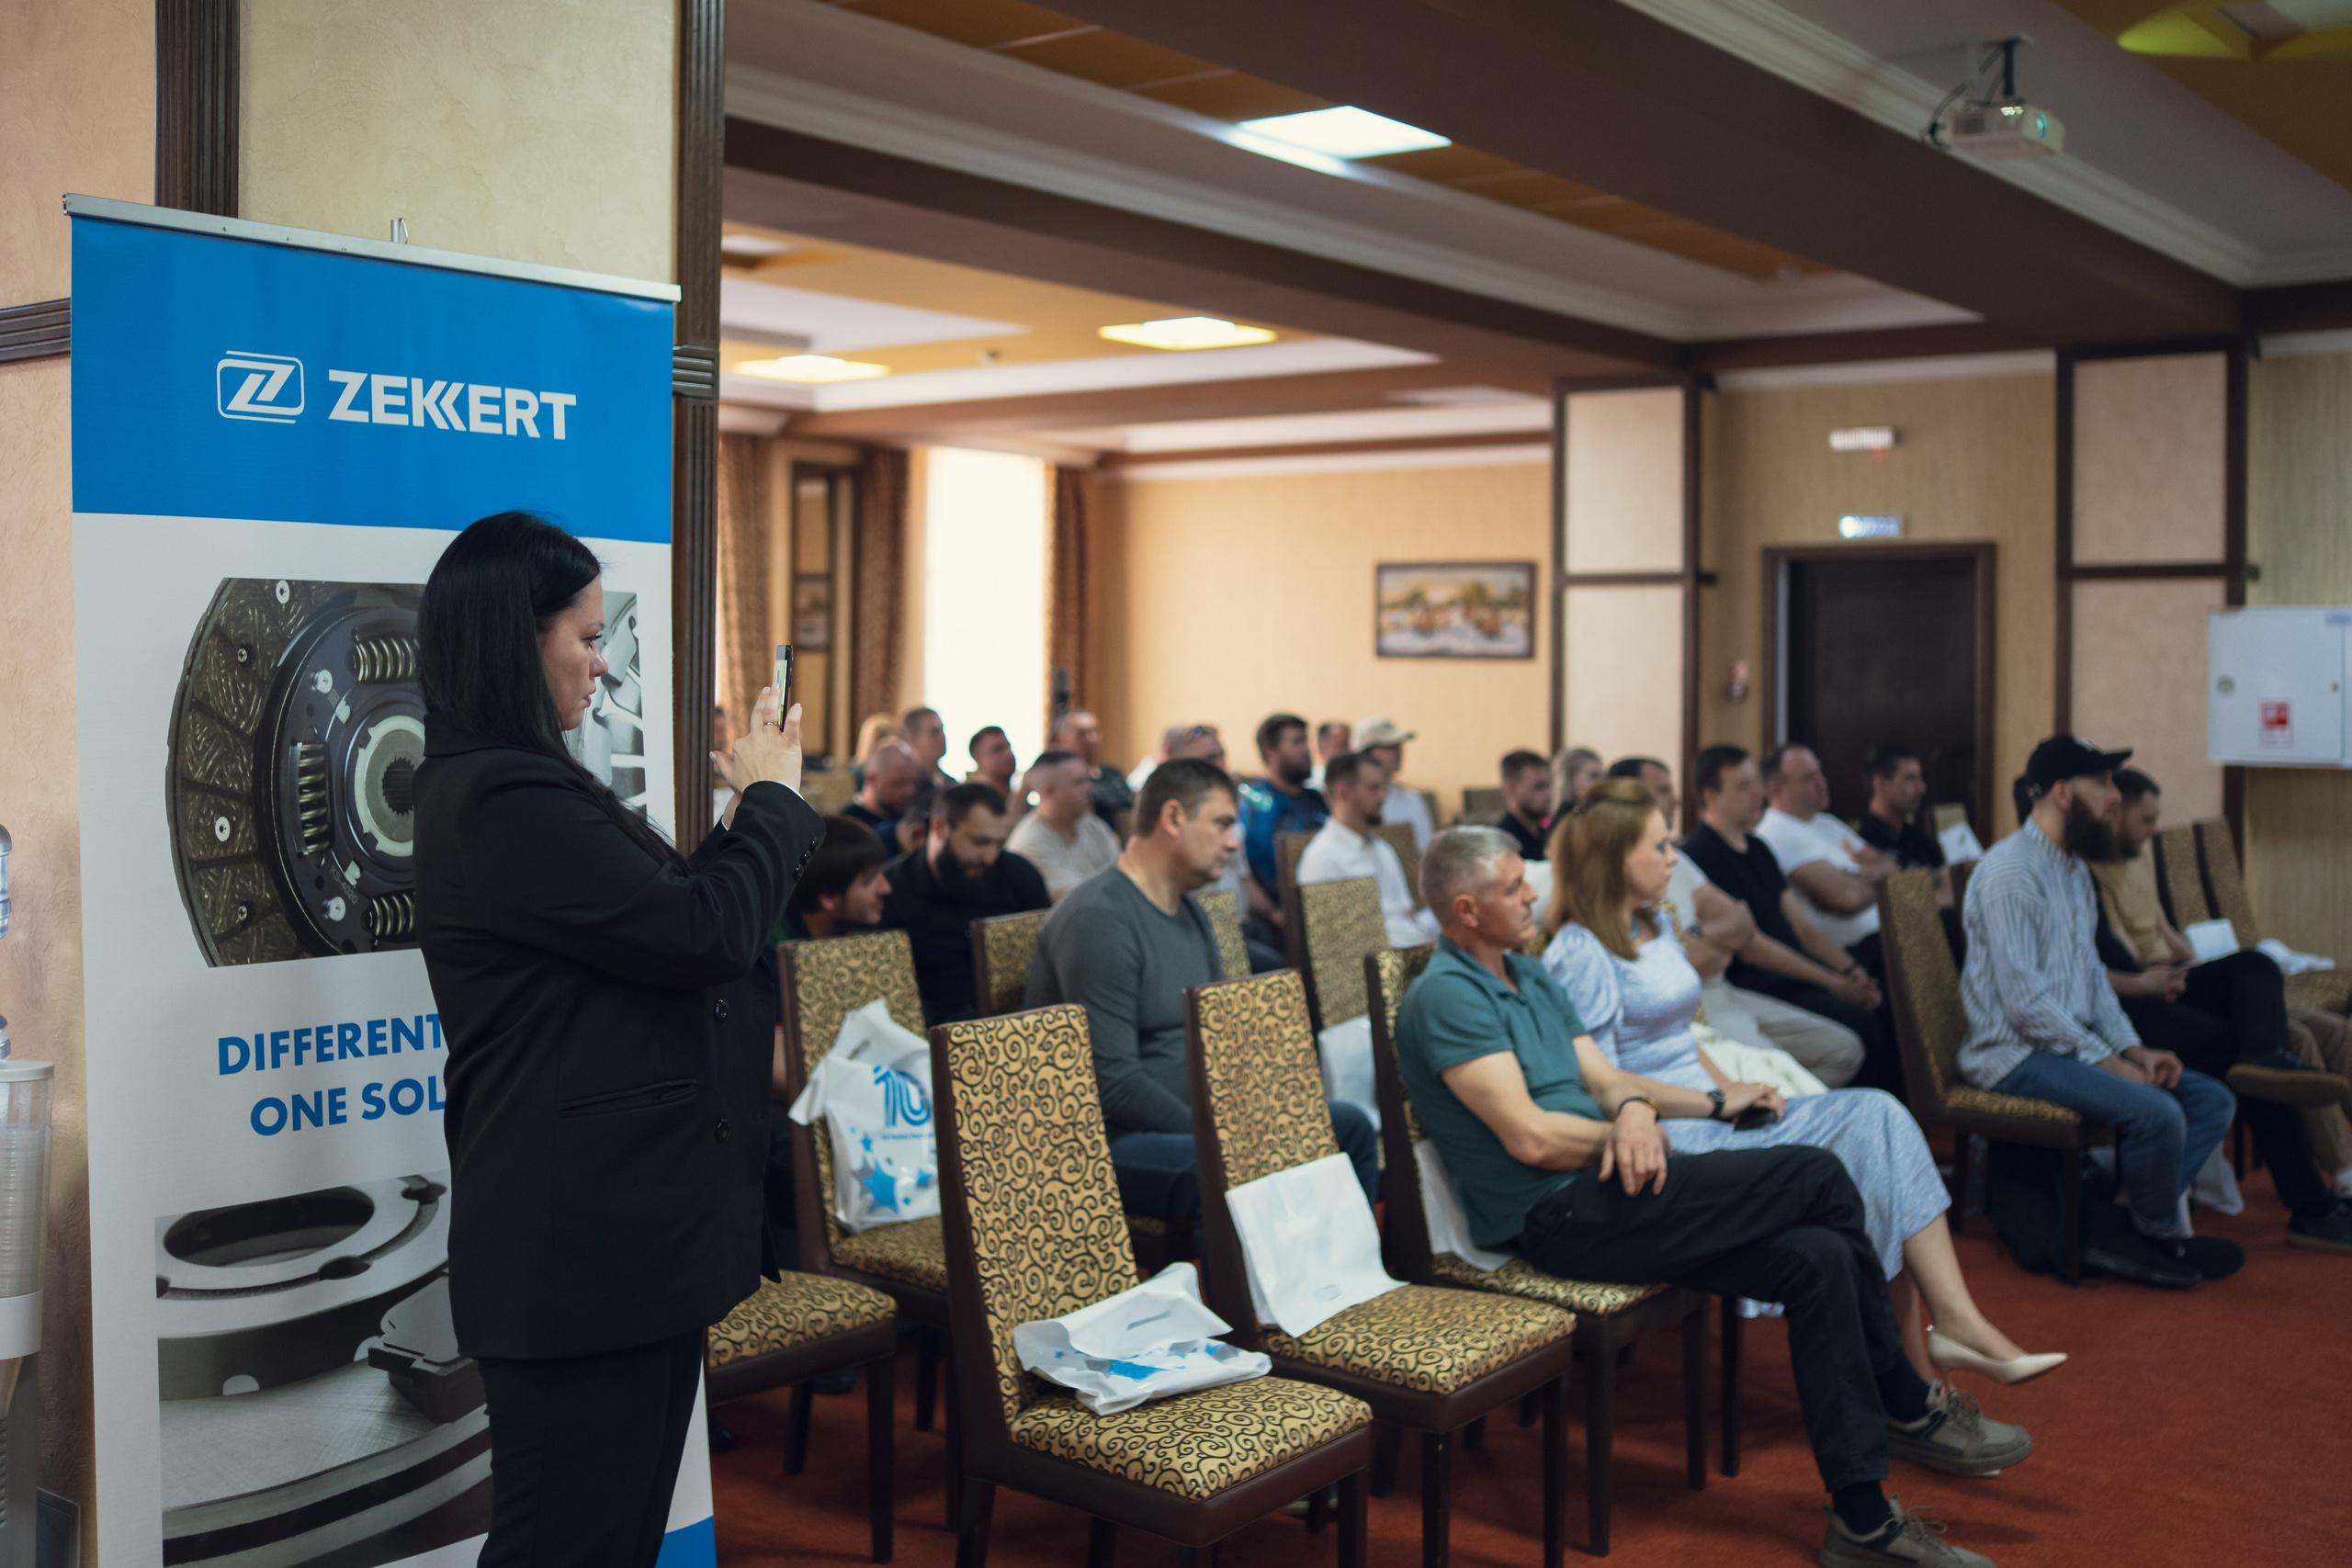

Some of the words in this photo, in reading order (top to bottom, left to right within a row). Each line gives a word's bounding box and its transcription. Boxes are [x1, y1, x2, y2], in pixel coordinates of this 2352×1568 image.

[328, 369, 577, 440] ZEKKERT
[218, 1012, 442, 1076] DIFFERENT
[250, 1087, 347, 1136] ONE
